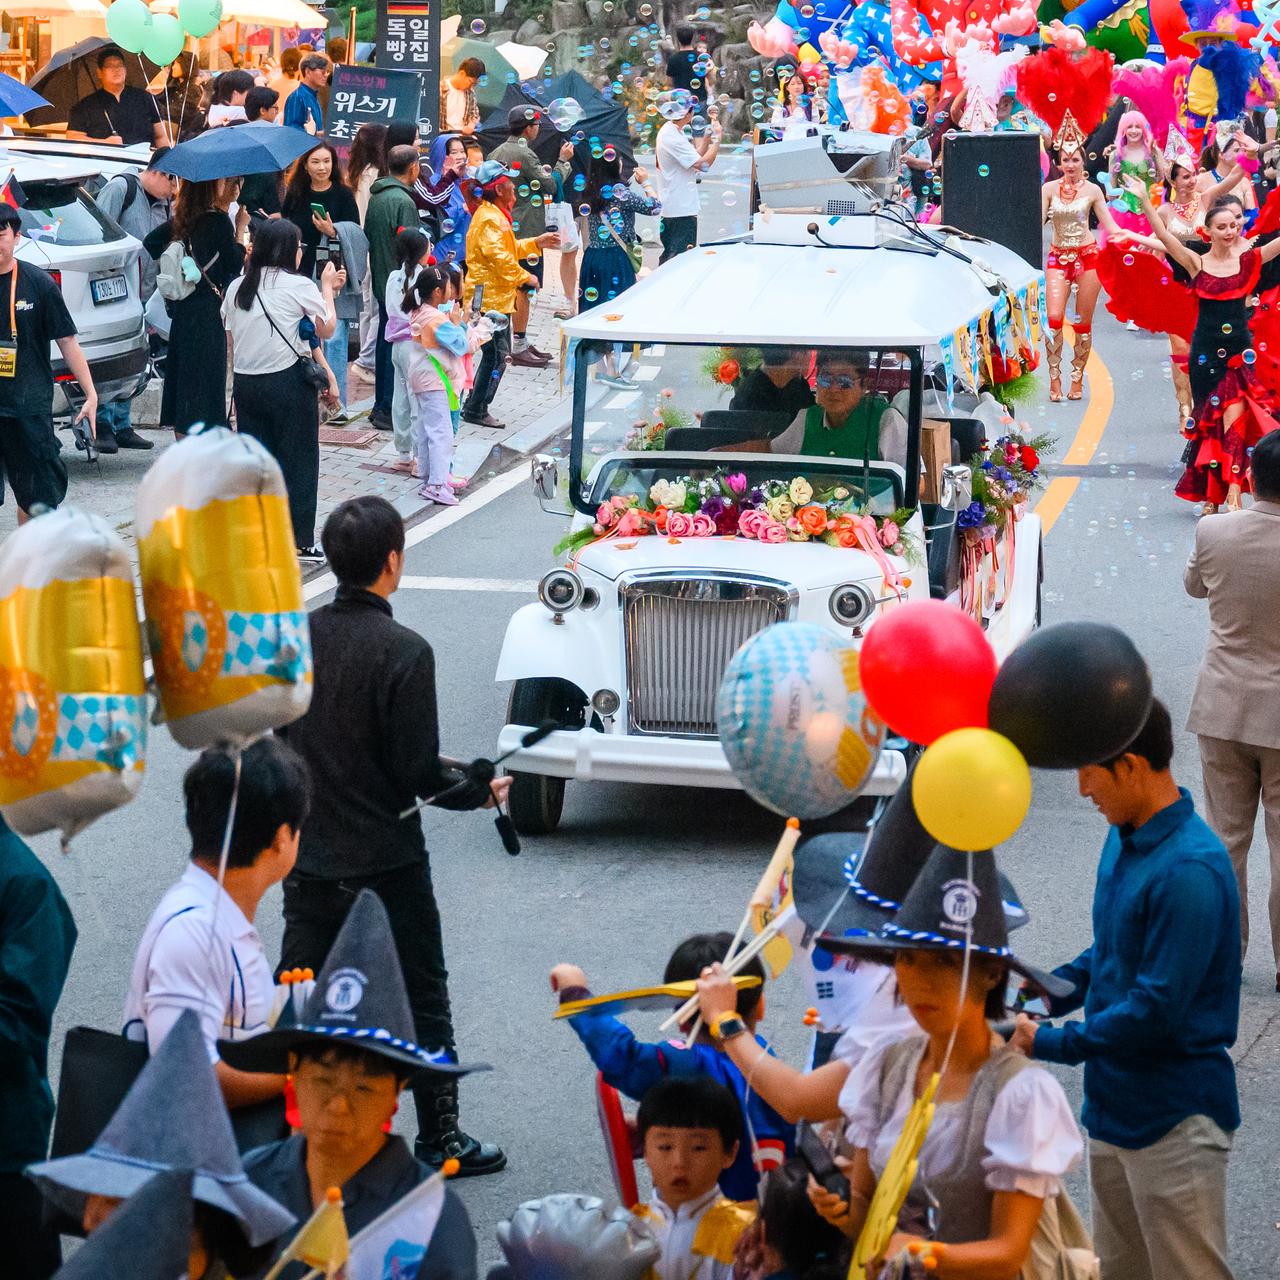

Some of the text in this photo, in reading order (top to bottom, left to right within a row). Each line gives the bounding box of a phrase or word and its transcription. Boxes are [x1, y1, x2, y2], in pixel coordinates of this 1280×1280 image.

[387, 18, 429, 40] 독일
[386, 41, 429, 63] 빵집
[334, 91, 397, 118] 위스키
